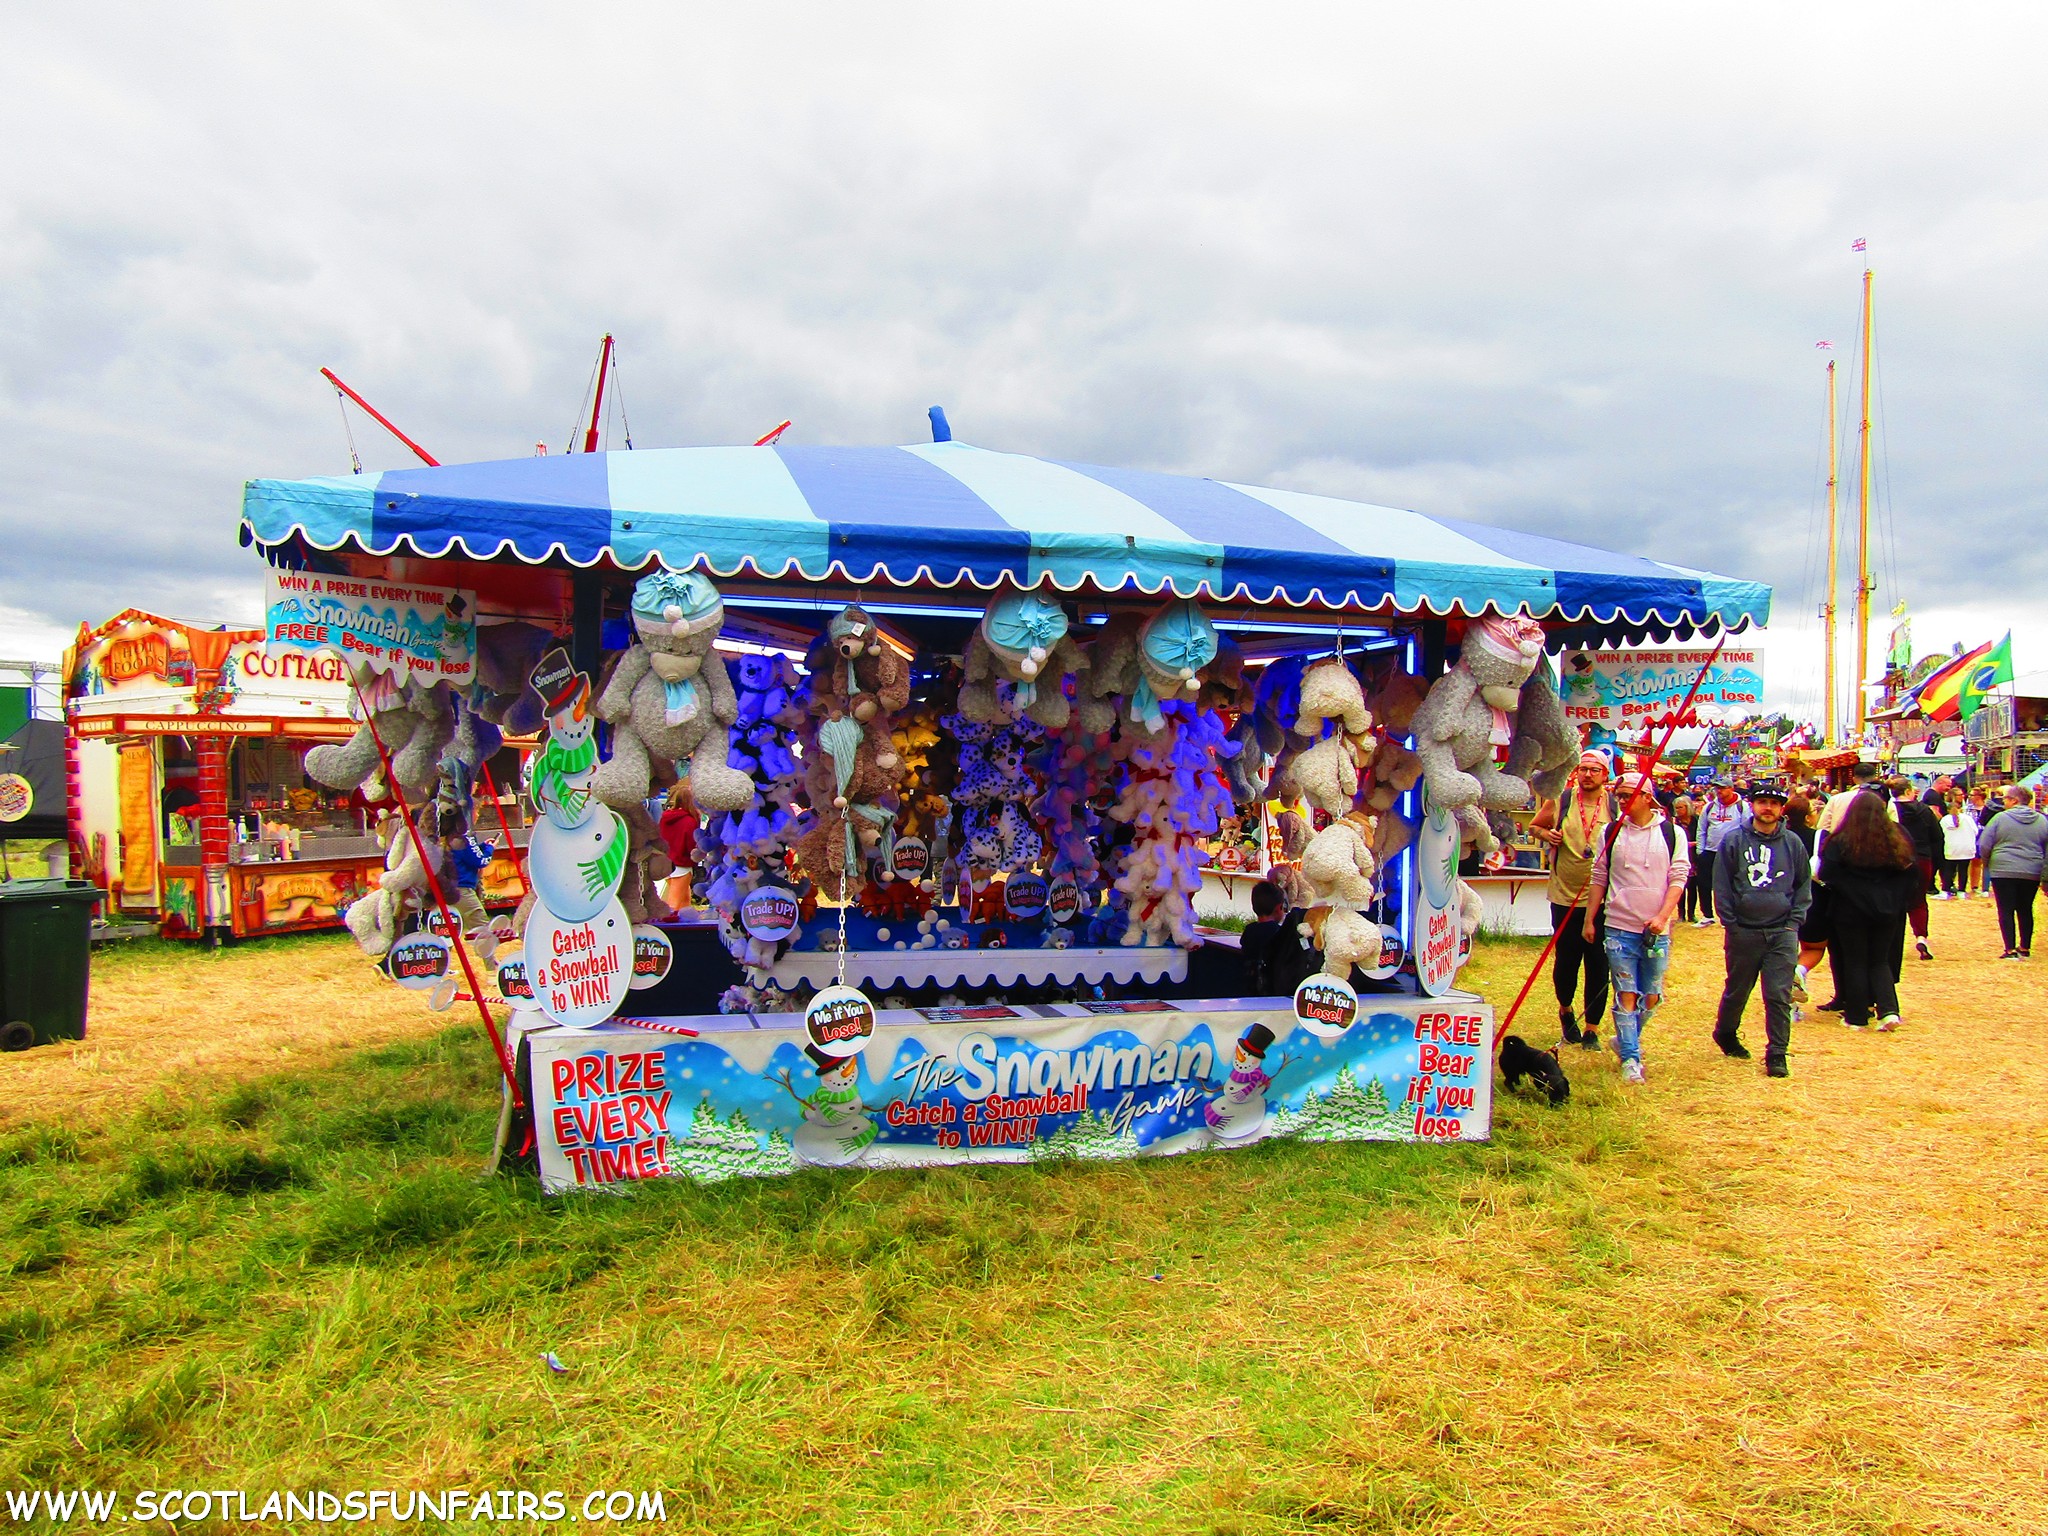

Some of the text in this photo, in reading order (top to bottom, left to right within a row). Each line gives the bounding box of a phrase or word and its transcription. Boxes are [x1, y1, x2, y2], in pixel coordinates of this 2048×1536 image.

[278, 575, 445, 606] WIN A PRIZE EVERY TIME
[280, 593, 443, 650] The Snowman Game
[274, 623, 471, 675] FREE Bear if you lose
[1595, 652, 1755, 664] WIN A PRIZE EVERY TIME
[534, 666, 572, 689] Snowman
[1609, 667, 1714, 699] Snowman
[1715, 671, 1753, 686] Game
[1565, 705, 1610, 719] FREE
[1621, 699, 1660, 716] Bear
[1666, 693, 1681, 708] if
[1721, 688, 1756, 704] lose
[145, 720, 247, 732] CAPPUCCINO
[894, 848, 927, 861] Trade UP!
[1227, 849, 1235, 859] 2
[1008, 886, 1045, 899] Trade UP!
[1051, 890, 1066, 903] Trade
[1066, 887, 1076, 899] UP!
[745, 902, 794, 916] Trade UP!
[1428, 909, 1448, 938] Catch
[552, 922, 596, 955] Catch
[636, 943, 664, 956] if You
[1384, 939, 1398, 951] You
[1422, 951, 1427, 966] a
[1427, 925, 1456, 963] Snowball
[398, 949, 442, 961] Me if You
[403, 960, 437, 976] Lose!
[538, 944, 619, 987] a Snowball
[1427, 967, 1436, 986] to
[1435, 950, 1453, 980] WIN!
[504, 968, 519, 980] Me
[508, 982, 533, 996] Los
[552, 975, 610, 1012] to WIN!
[1304, 988, 1350, 1009] Me if You
[814, 1004, 864, 1026] Me if You
[1306, 1003, 1343, 1023] Lose!
[822, 1017, 862, 1042] Lose!
[1414, 1013, 1482, 1044] FREE
[893, 1031, 1214, 1104] The Snowman
[1418, 1044, 1475, 1076] Bear
[552, 1051, 665, 1102] PRIZE
[886, 1083, 1088, 1126] Catch a Snowball
[1407, 1075, 1475, 1118] if you
[552, 1090, 672, 1146] EVERY
[1111, 1086, 1203, 1138] Game
[1413, 1108, 1463, 1138] lose
[936, 1118, 1038, 1148] to WIN!!
[563, 1135, 672, 1184] TIME!
